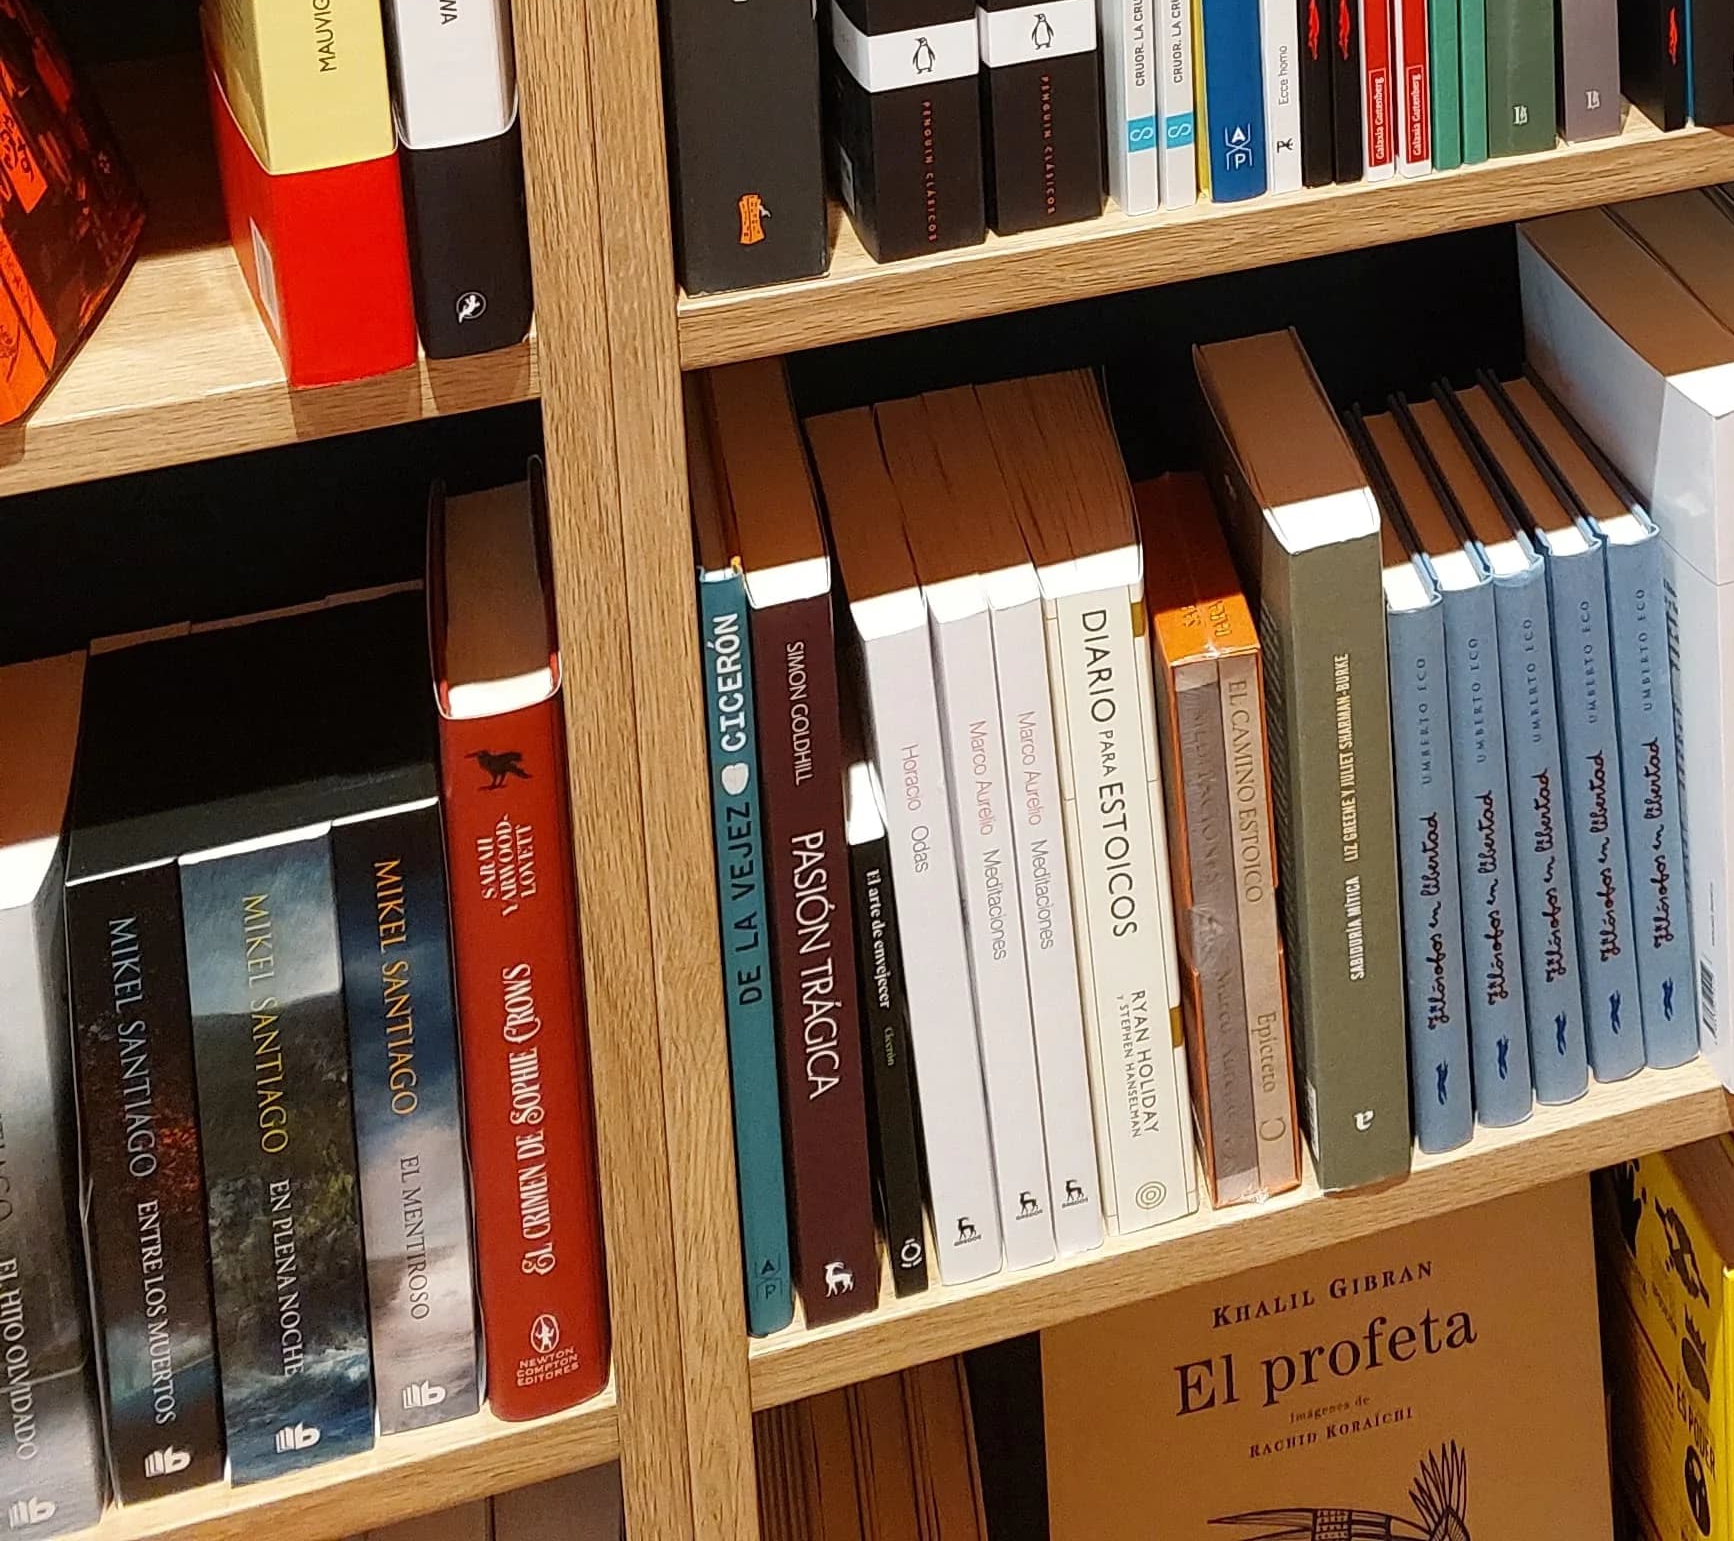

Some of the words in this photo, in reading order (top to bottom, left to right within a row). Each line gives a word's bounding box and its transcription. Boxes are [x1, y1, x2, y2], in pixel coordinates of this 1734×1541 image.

[709, 611, 748, 751] CICERÓN
[1082, 609, 1115, 722] DIARIO
[1099, 729, 1116, 776] PARA
[374, 860, 406, 953] MIKEL
[791, 830, 833, 953] PASIÓN
[1098, 781, 1137, 936] ESTOICOS
[381, 960, 417, 1113] SANTIAGO
[800, 957, 841, 1099] TRÁGICA
[513, 1130, 547, 1162] DE
[518, 1163, 550, 1238] CRIMEN
[1173, 1353, 1239, 1415] El
[1260, 1308, 1477, 1405] profeta
